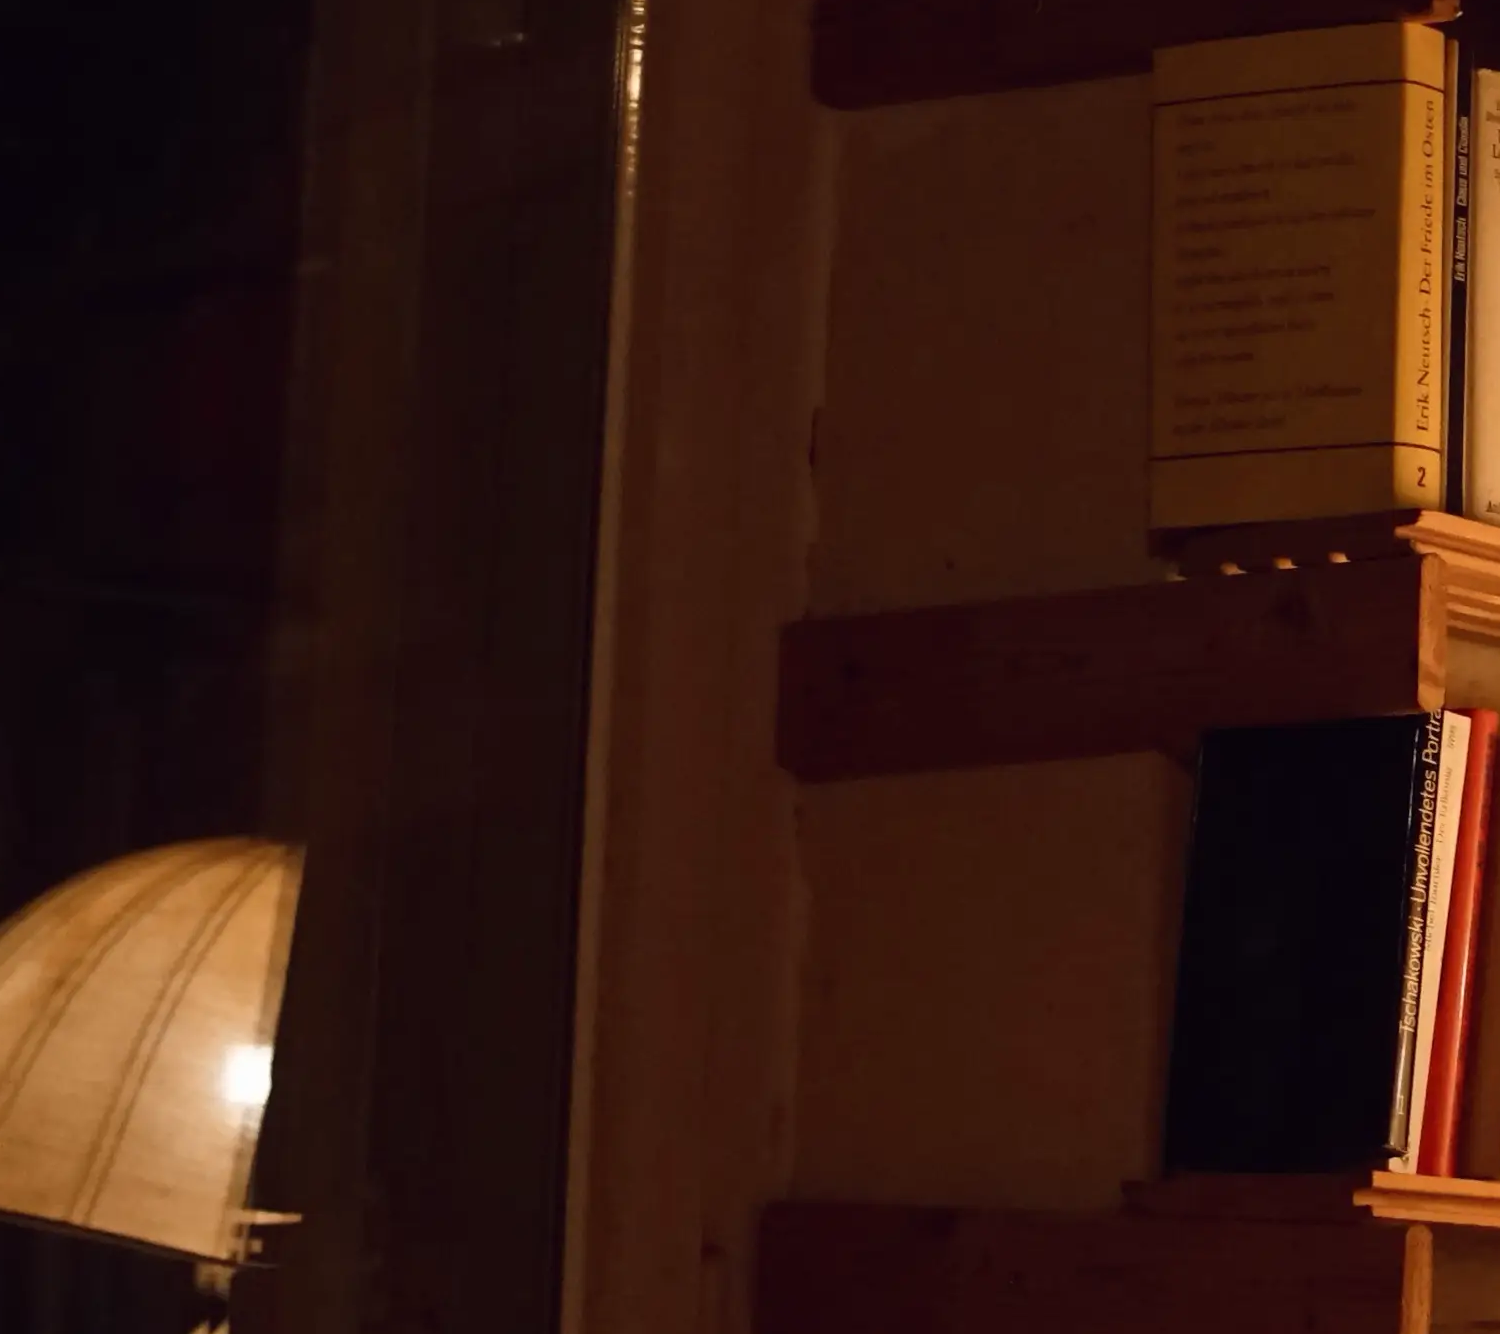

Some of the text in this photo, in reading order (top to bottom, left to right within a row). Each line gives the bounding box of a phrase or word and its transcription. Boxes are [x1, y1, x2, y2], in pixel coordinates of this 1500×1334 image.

[1457, 155, 1469, 177] und
[1454, 216, 1467, 261] Neutsch
[1414, 99, 1438, 433] Erik Neutsch Der Friede im Osten
[1453, 260, 1467, 282] Erik
[1414, 466, 1426, 487] 2
[1399, 770, 1438, 1033] Tschakowski Unvollendetes
